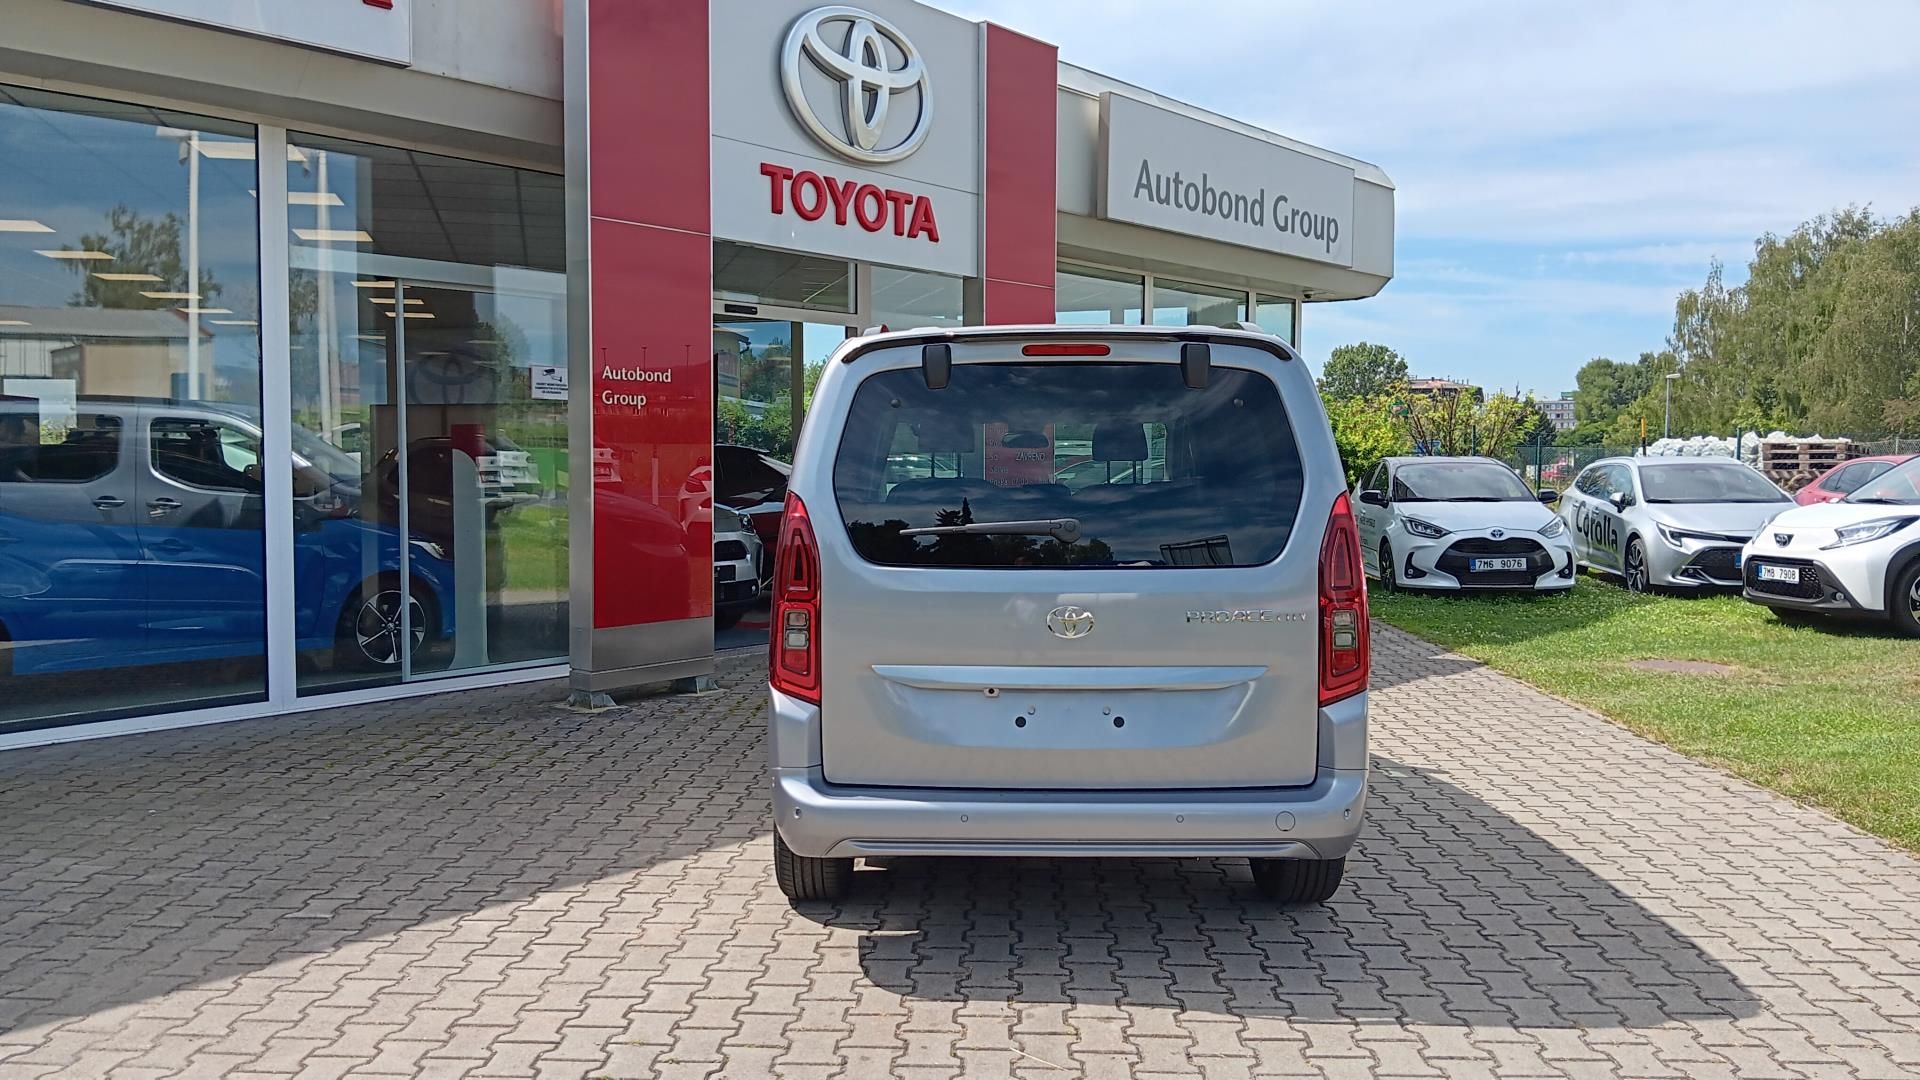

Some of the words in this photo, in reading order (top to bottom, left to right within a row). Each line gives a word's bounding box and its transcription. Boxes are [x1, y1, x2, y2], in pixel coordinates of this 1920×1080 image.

[760, 162, 940, 243] TOYOTA
[1133, 158, 1265, 227] Autobond
[1272, 194, 1340, 254] Group
[601, 365, 672, 383] Autobond
[601, 389, 647, 410] Group
[1575, 501, 1618, 553] Corolla
[1477, 559, 1494, 569] 7M6
[1500, 559, 1523, 569] 9076
[1779, 568, 1797, 580] 7908
[1185, 609, 1273, 624] PROACE
